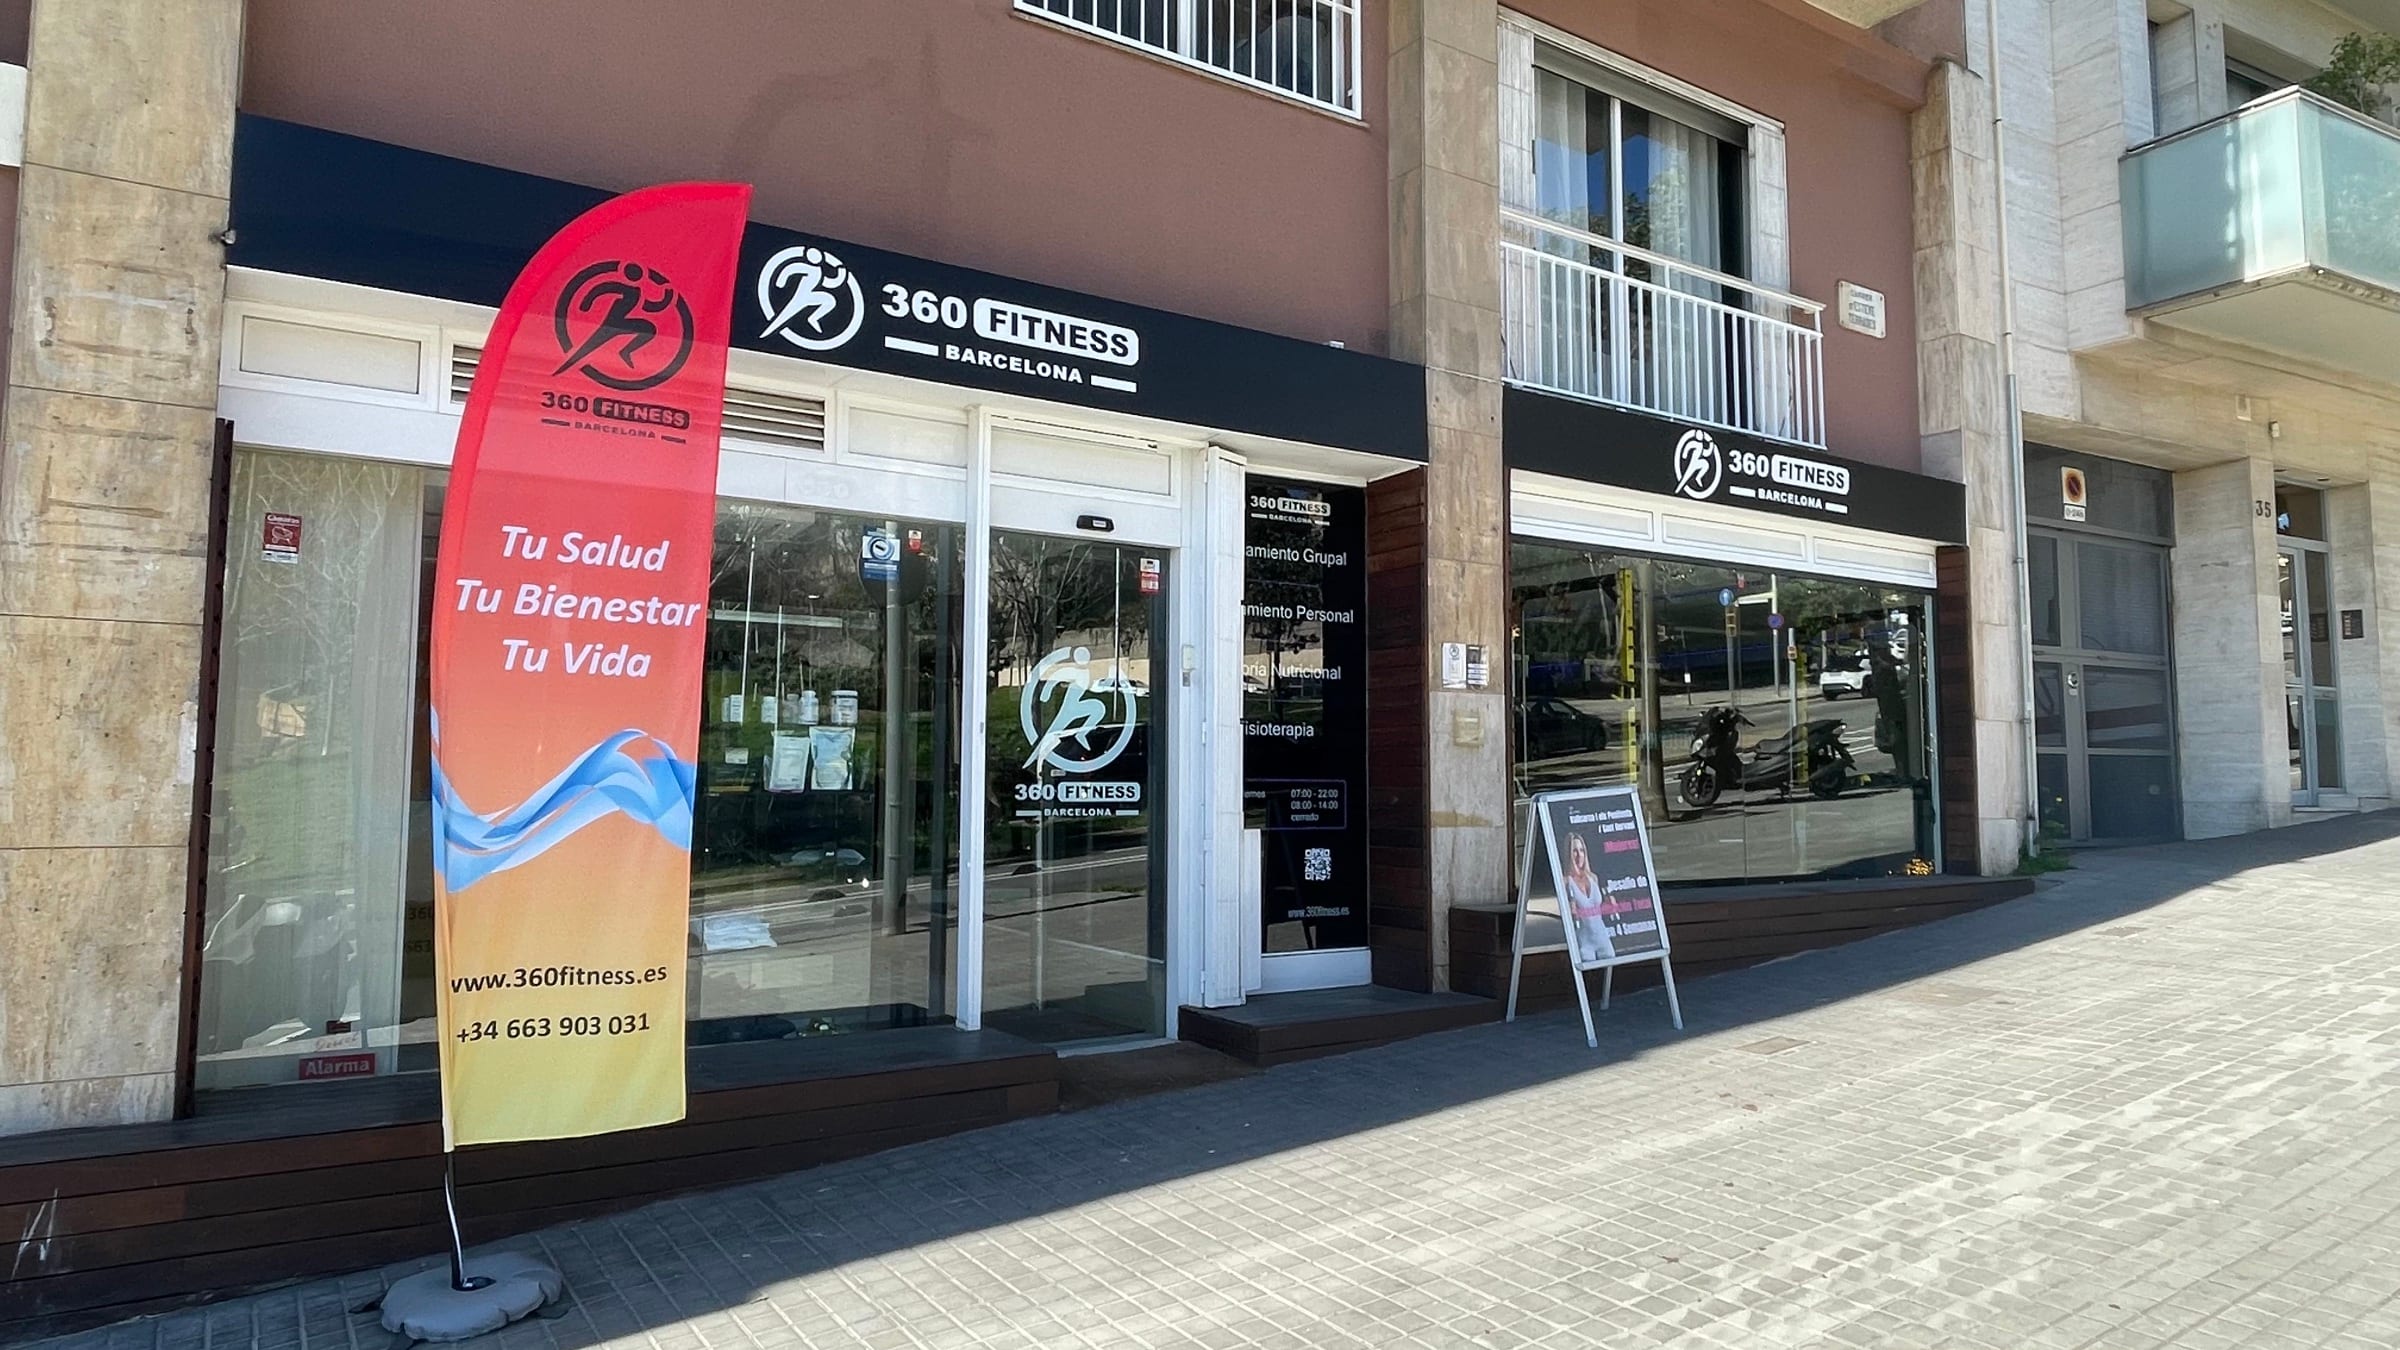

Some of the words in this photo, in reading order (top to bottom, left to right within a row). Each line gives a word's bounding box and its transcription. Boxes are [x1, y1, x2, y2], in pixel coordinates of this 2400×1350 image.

[881, 283, 968, 330] 360
[989, 307, 1129, 358] FITNESS
[945, 343, 1084, 385] BARCELONA
[541, 391, 588, 413] 360
[600, 402, 685, 427] FITNESS
[574, 421, 656, 439] BARCELONA
[1728, 450, 1770, 478] 360
[1779, 461, 1846, 489] FITNESS
[1250, 495, 1276, 509] 360
[1281, 500, 1329, 514] FITNESS
[1758, 488, 1823, 510] BARCELONA
[2255, 500, 2272, 518] 35
[1269, 513, 1312, 524] BARCELONA
[501, 525, 548, 561] Tu
[556, 531, 670, 571] Salud
[1302, 547, 1347, 568] Grupal
[455, 578, 502, 614] Tu
[513, 583, 701, 627] Bienestar
[1296, 604, 1354, 624] Personal
[502, 638, 549, 673] Tu
[564, 642, 652, 678] Vida
[1271, 663, 1341, 681] Nutricional
[1014, 784, 1054, 801] 360
[1064, 785, 1136, 800] FITNESS
[1044, 808, 1112, 816] BARCELONA
[451, 965, 668, 993] www.360fitness.es
[456, 1020, 499, 1043] +34
[506, 1018, 552, 1039] 663
[559, 1016, 602, 1036] 903
[607, 1012, 651, 1035] 031
[305, 1059, 371, 1076] Alarma
